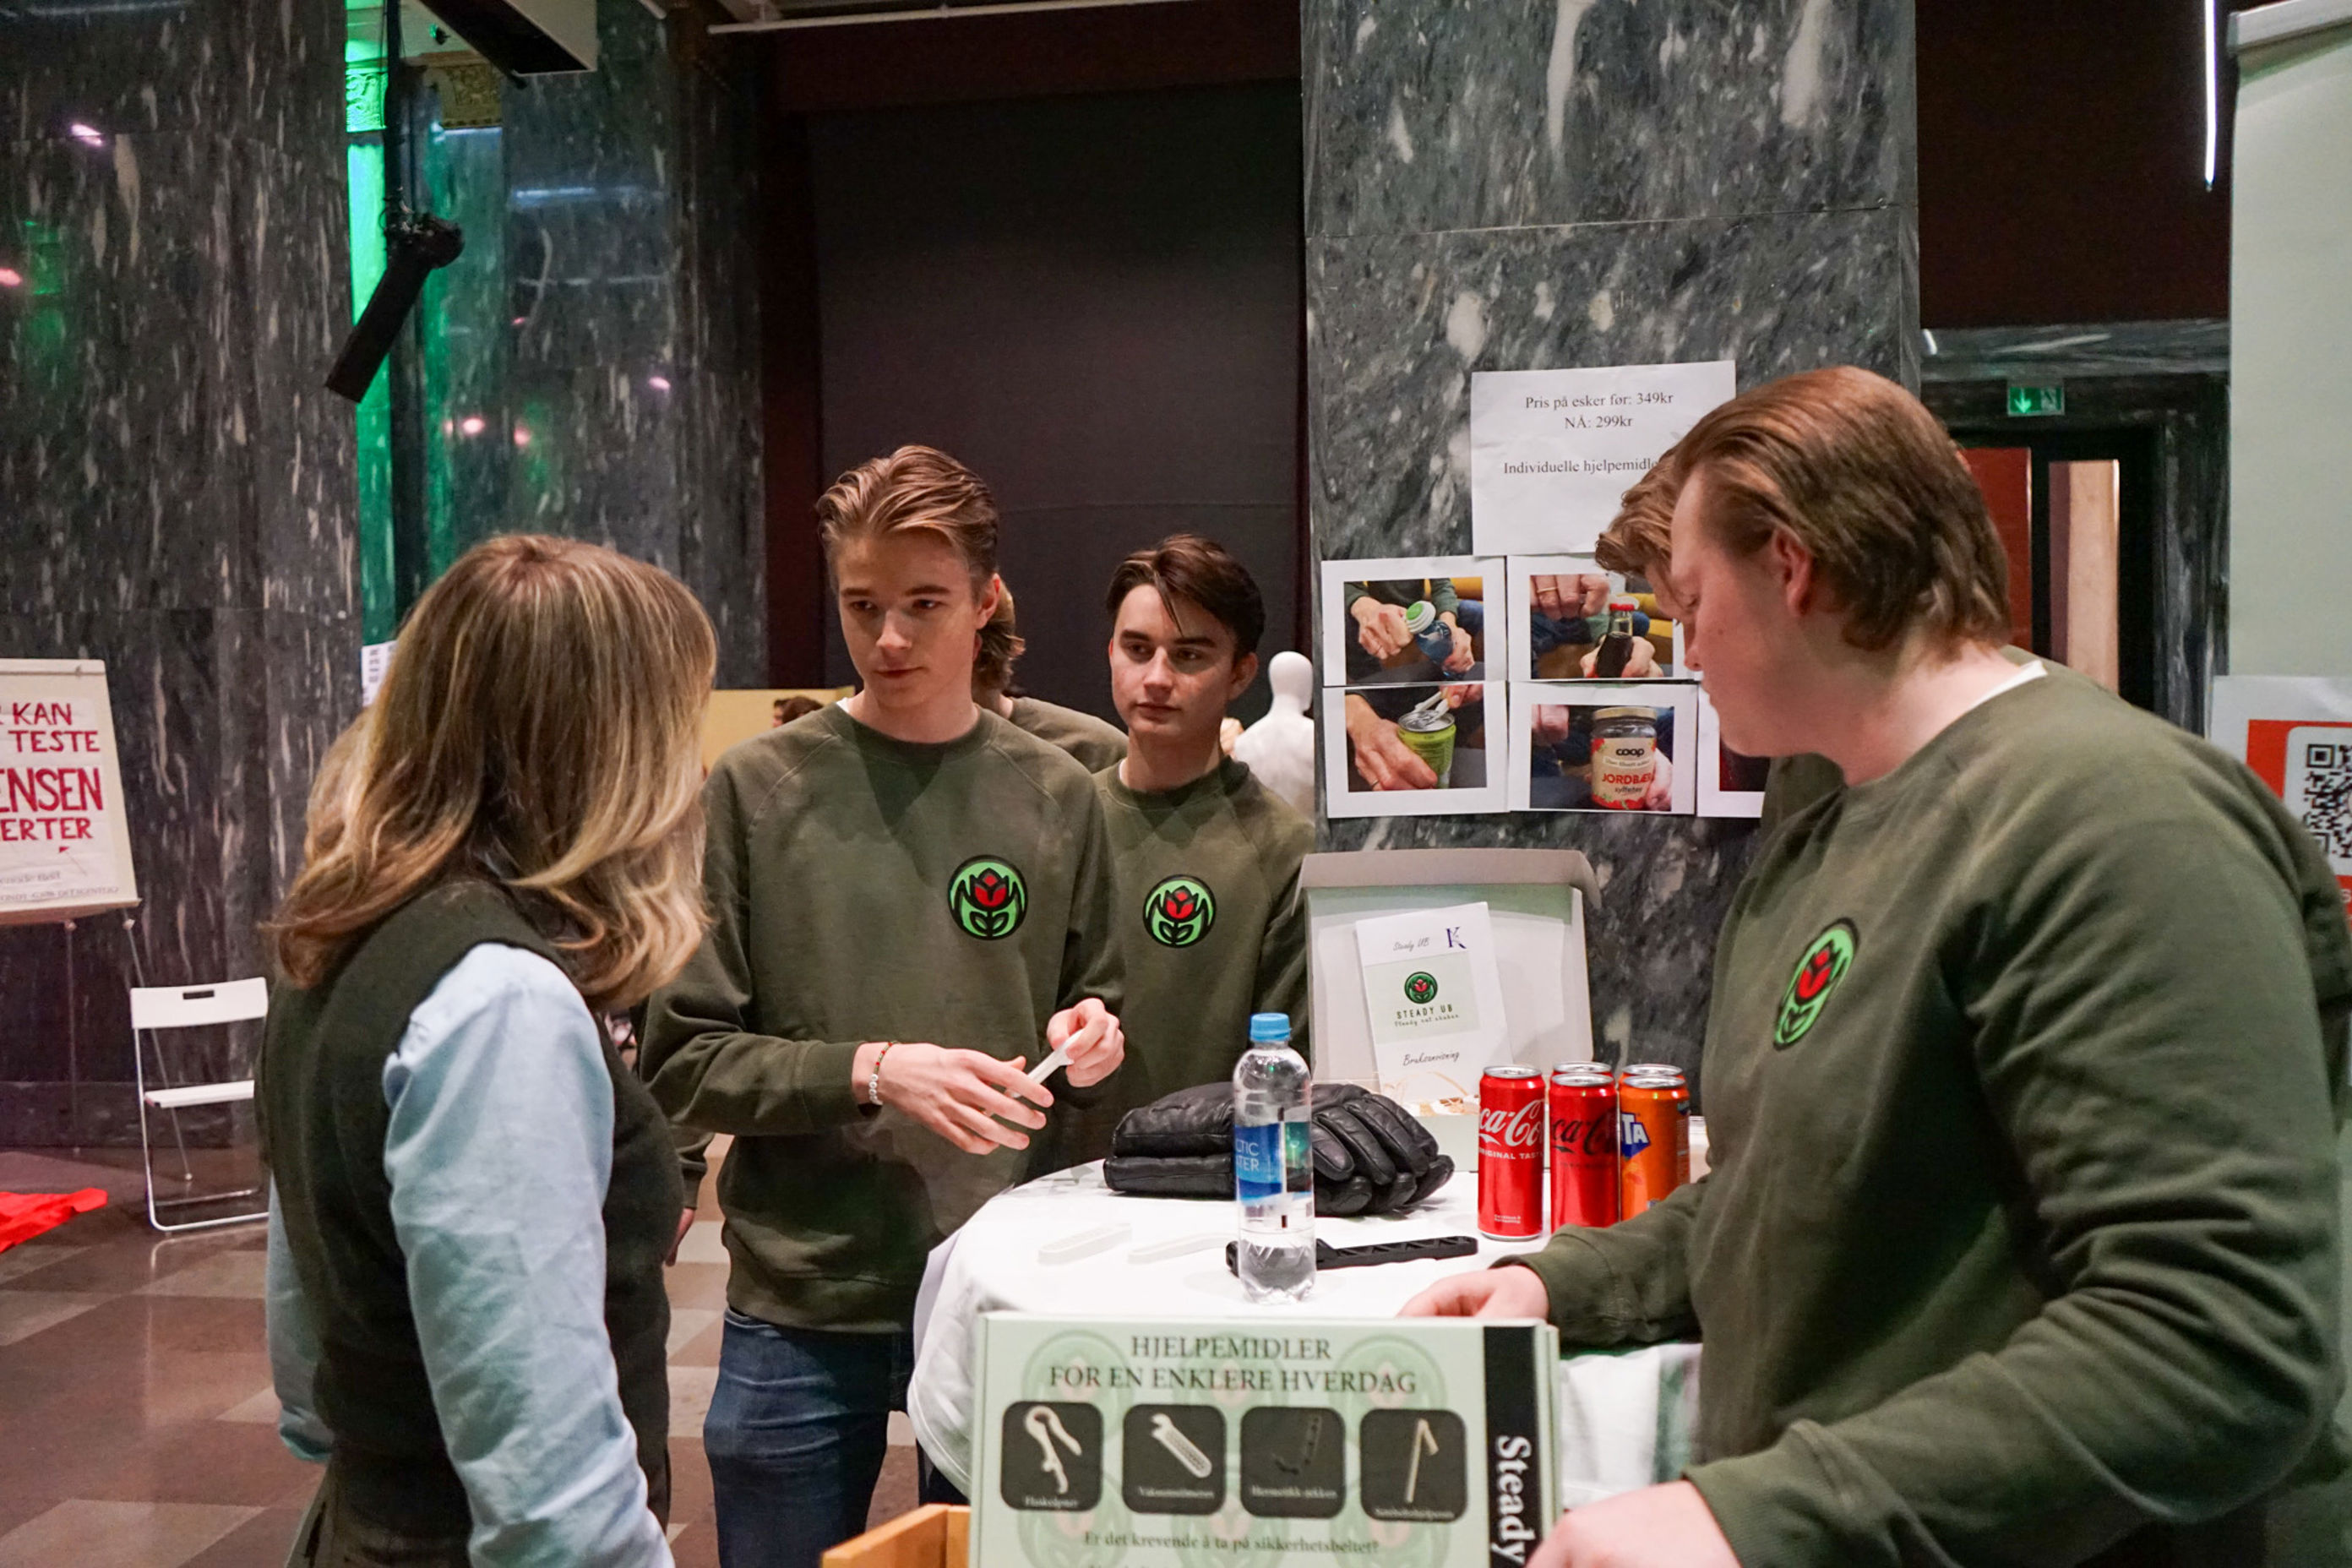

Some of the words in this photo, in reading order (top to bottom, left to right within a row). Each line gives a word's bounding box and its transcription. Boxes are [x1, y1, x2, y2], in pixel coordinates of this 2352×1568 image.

[1526, 396, 1549, 409] Pris
[1554, 395, 1568, 411] på
[1572, 395, 1606, 407] esker
[1610, 394, 1632, 406] før:
[1636, 392, 1674, 405] 349kr
[1565, 415, 1592, 429] NÅ:
[1596, 415, 1633, 428] 299kr
[1504, 460, 1580, 474] Individuelle
[13, 703, 72, 726] KAN
[8, 730, 100, 753] TESTE
[1616, 749, 1645, 757] coop
[1396, 1006, 1435, 1020] STEADY
[1440, 1004, 1453, 1014] UB
[1132, 1336, 1331, 1359] HJELPEMIDLER
[1050, 1366, 1101, 1387] FOR
[1109, 1367, 1142, 1389] EN
[1152, 1368, 1273, 1391] ENKLERE
[1281, 1370, 1417, 1394] HVERDAG
[1491, 1435, 1536, 1565] Steady
[1104, 1531, 1128, 1546] det
[1131, 1533, 1198, 1548] krevende
[1202, 1534, 1210, 1549] å
[1215, 1537, 1228, 1549] ta
[1233, 1535, 1250, 1554] på
